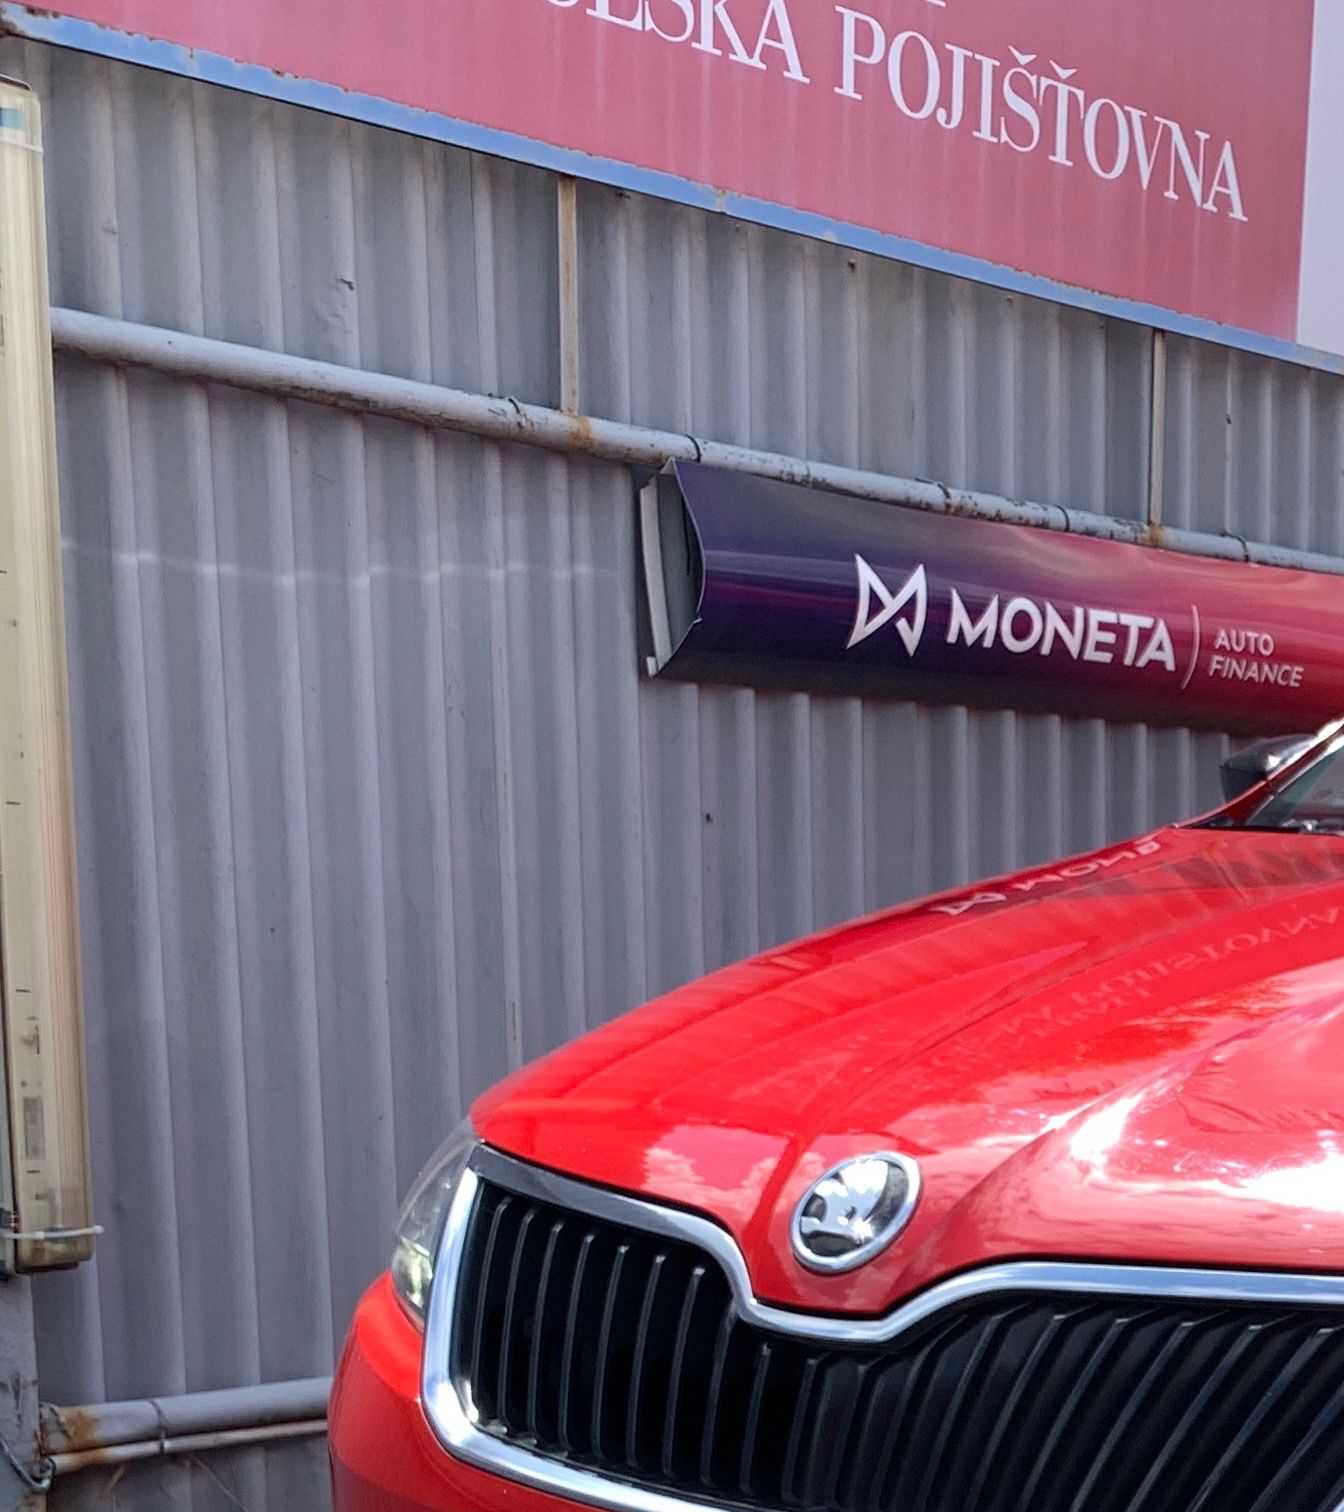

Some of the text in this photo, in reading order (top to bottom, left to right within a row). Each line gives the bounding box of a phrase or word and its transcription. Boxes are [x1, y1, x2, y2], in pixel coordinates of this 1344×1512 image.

[834, 5, 1248, 222] POJIŠŤOVNA
[947, 588, 1175, 672] MONETA
[1213, 629, 1275, 656] AUTO
[1208, 655, 1306, 688] FINANCE
